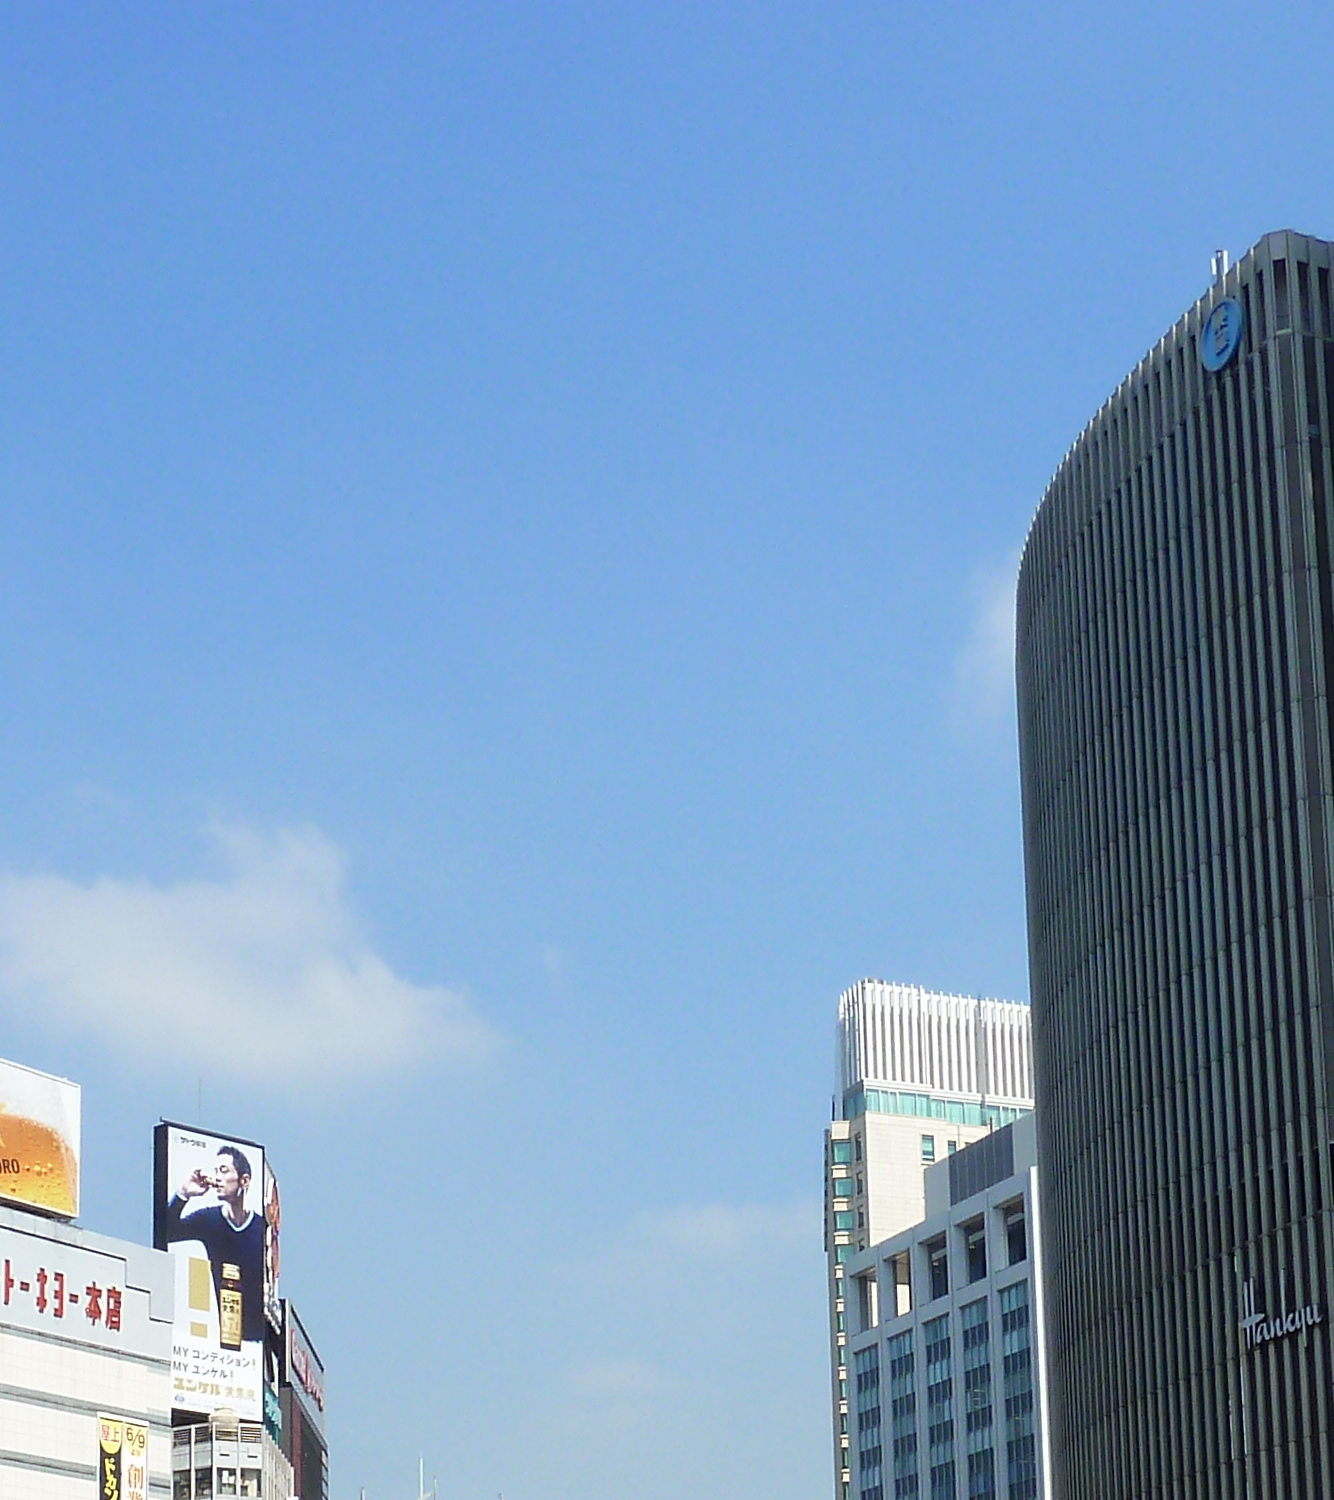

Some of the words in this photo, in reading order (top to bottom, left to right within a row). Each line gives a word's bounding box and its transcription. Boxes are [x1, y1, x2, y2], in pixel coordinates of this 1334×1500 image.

[1241, 1269, 1323, 1350] Hankyu
[172, 1345, 189, 1358] MY
[172, 1361, 189, 1373] MY
[173, 1377, 222, 1396] ユンケル
[126, 1426, 146, 1449] 6/9
